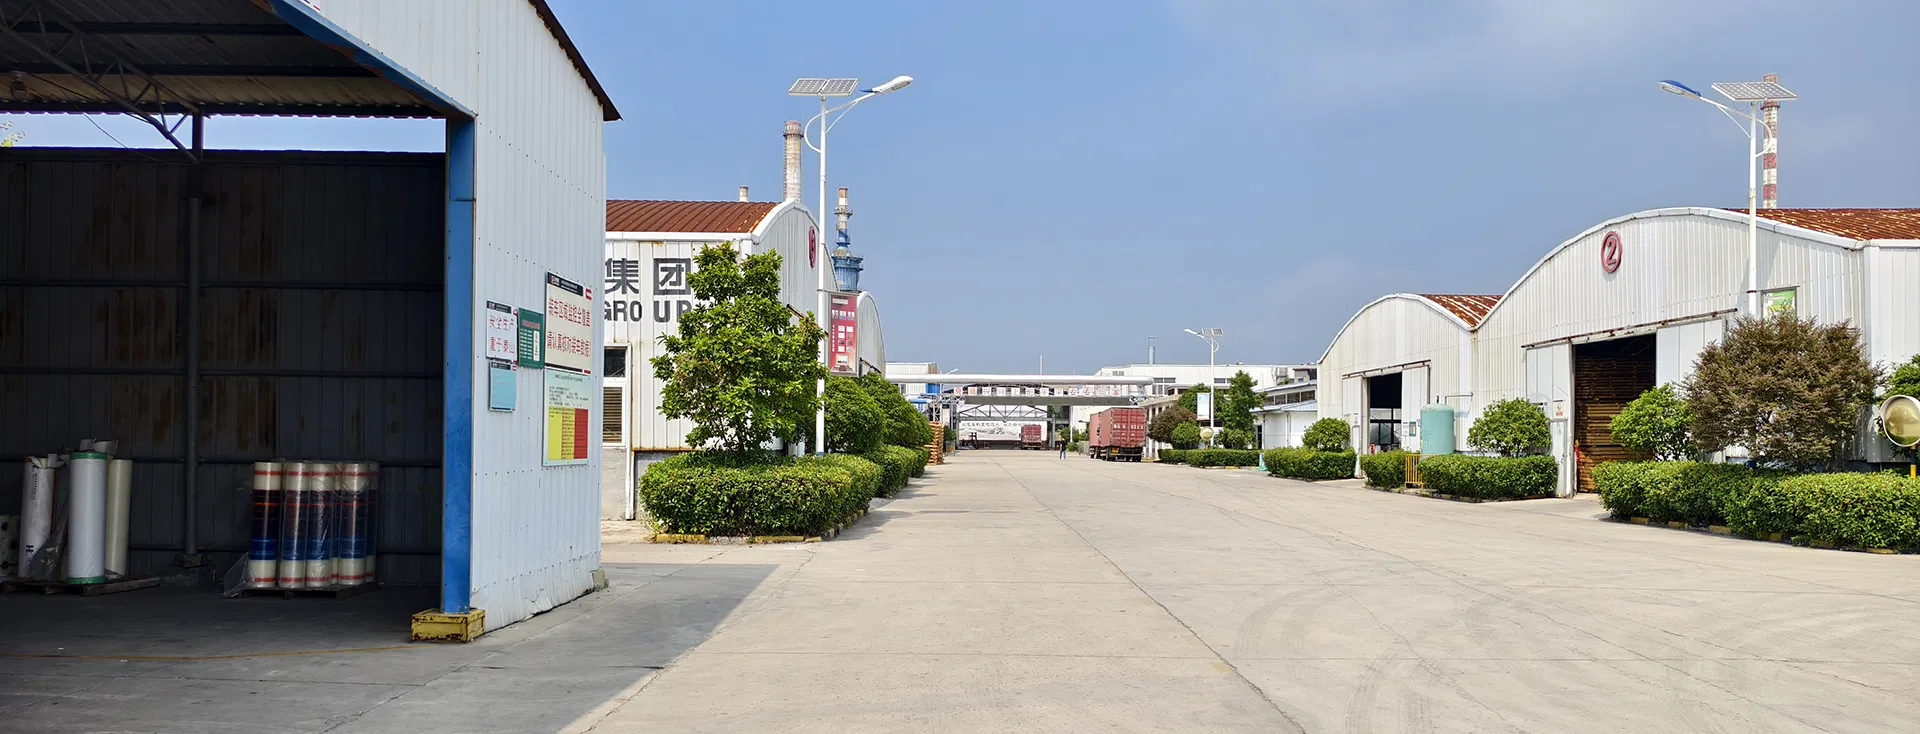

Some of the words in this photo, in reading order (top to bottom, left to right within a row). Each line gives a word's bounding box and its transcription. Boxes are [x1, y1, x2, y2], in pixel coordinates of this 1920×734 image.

[605, 258, 691, 295] 集团
[490, 315, 515, 331] 安全生产
[490, 336, 515, 354] 重于泰山
